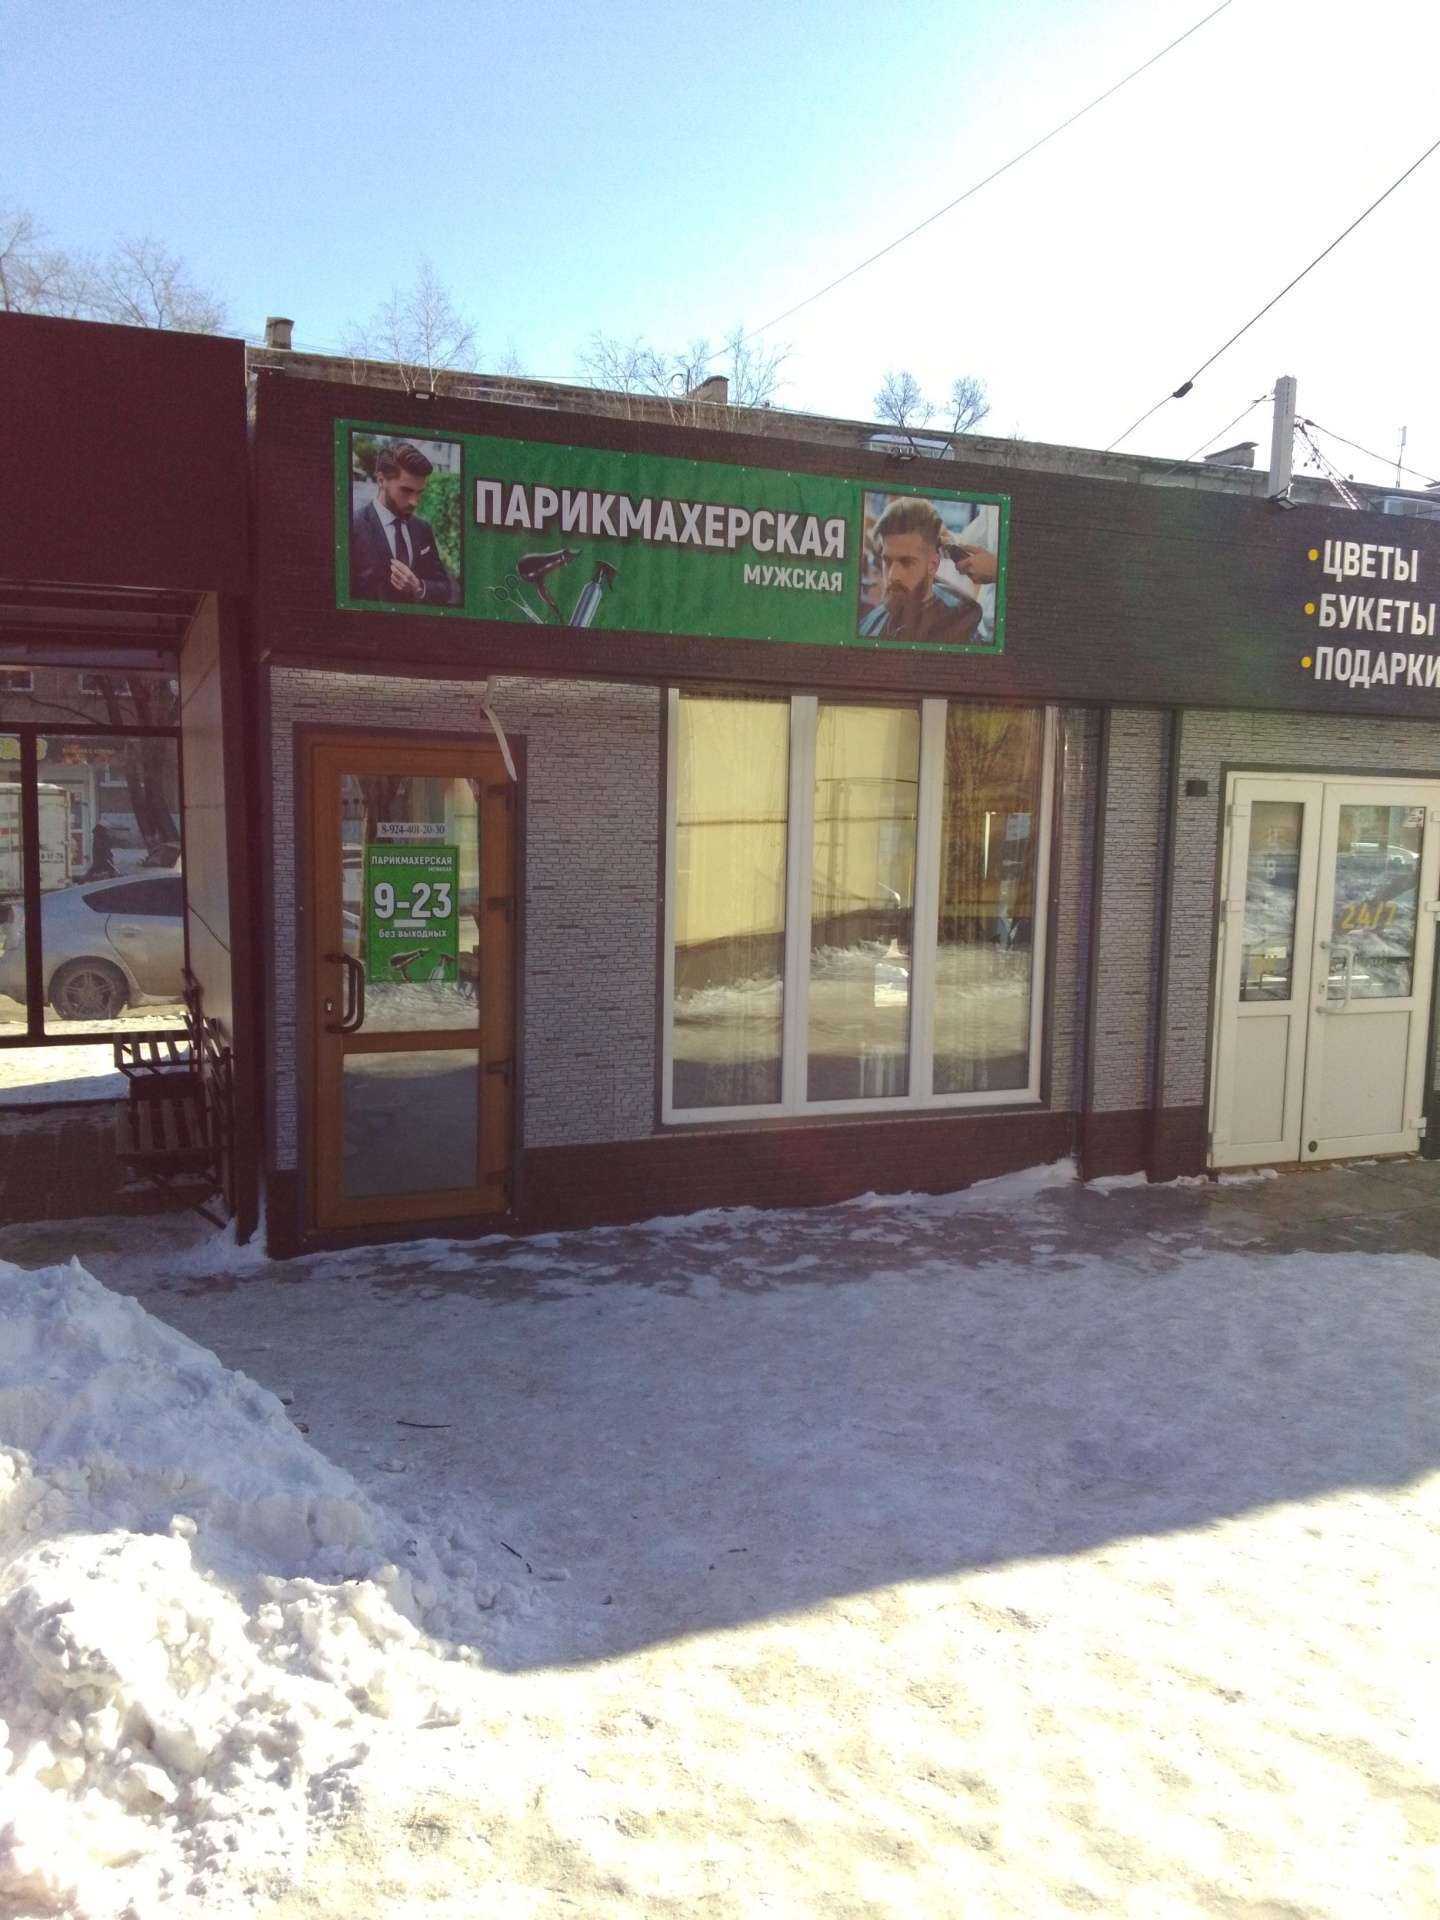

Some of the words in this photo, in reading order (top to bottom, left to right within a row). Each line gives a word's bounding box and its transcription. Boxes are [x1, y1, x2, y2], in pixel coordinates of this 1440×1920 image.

[476, 480, 845, 558] ПАРИКМАХЕРСКАЯ
[744, 564, 842, 592] МУЖСКАЯ
[1323, 540, 1418, 582] ЦВЕТЫ
[1319, 593, 1436, 636] БУКЕТЫ
[1314, 646, 1440, 688] ПОДАРКИ
[371, 855, 452, 865] ПАРИКМАХЕРСКАЯ
[374, 882, 452, 918] 9-23
[1341, 902, 1396, 929] 24/7
[379, 928, 395, 938] без
[398, 929, 447, 938] выходных
